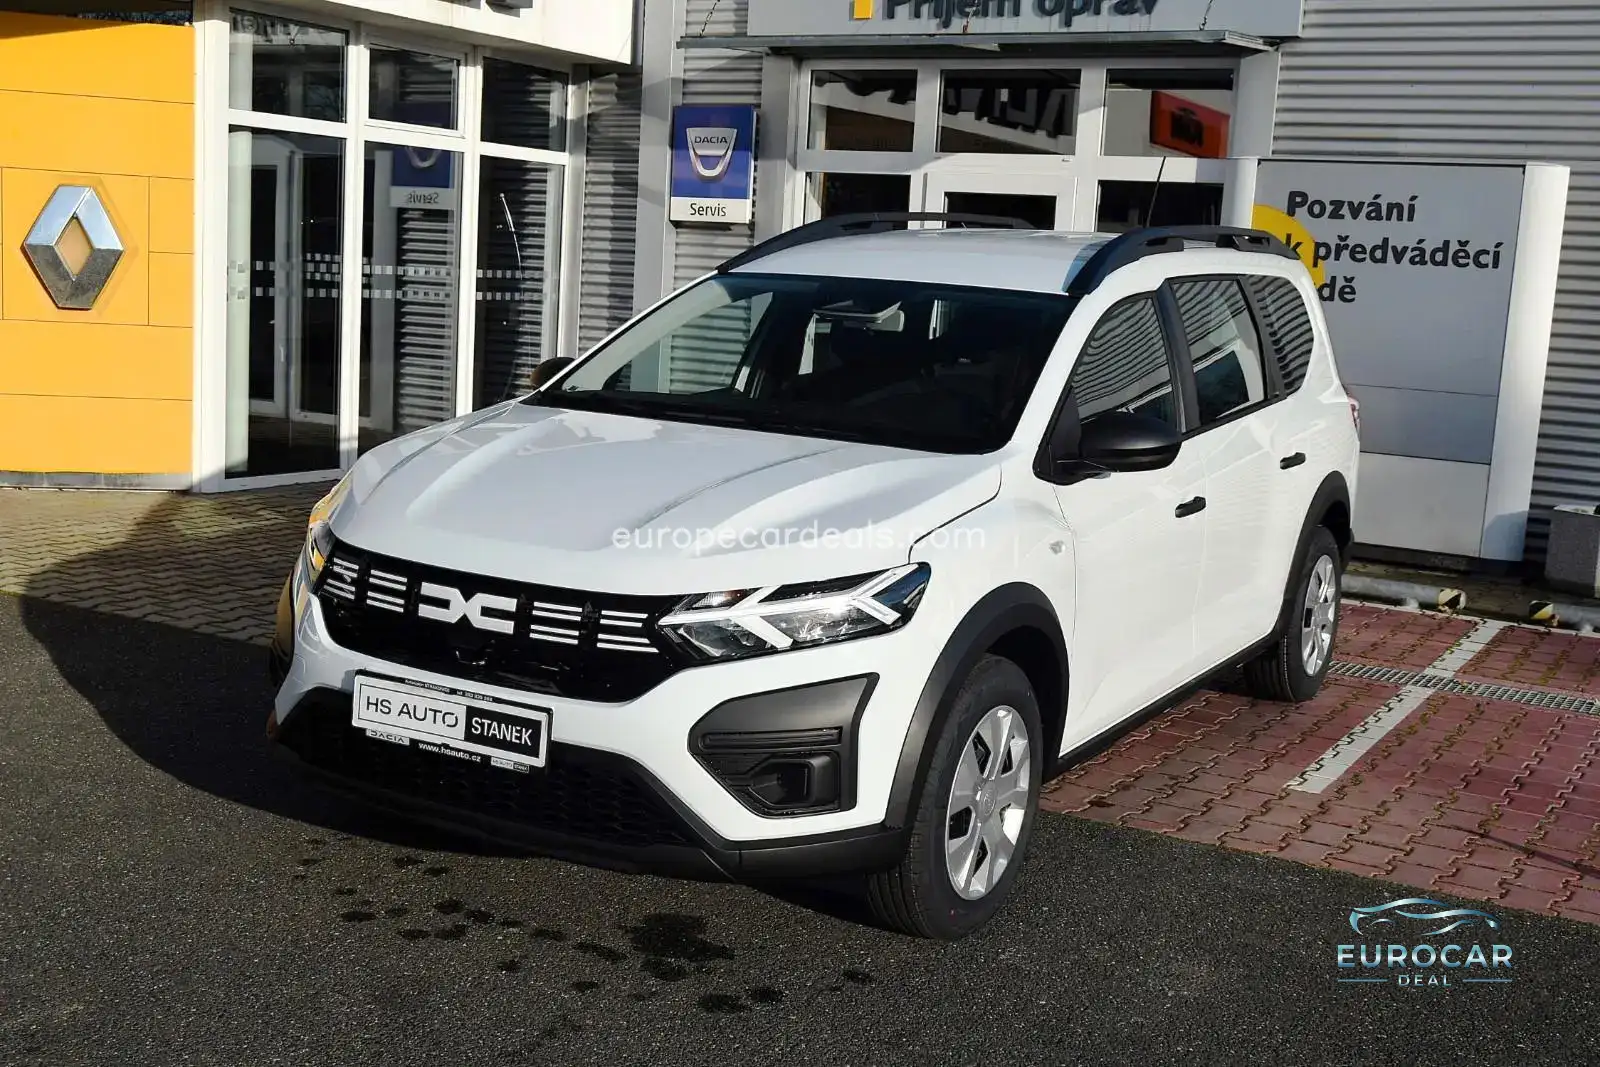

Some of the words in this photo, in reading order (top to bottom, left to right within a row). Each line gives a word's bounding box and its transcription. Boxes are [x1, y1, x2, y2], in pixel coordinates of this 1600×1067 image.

[694, 136, 728, 144] DACIA
[690, 203, 727, 217] Servis
[1286, 190, 1419, 222] Pozvání
[1312, 234, 1504, 269] předváděcí
[366, 696, 392, 714] HS
[398, 702, 459, 728] AUTO
[471, 717, 533, 746] STANEK
[370, 730, 405, 744] DACIA
[418, 741, 482, 763] www.hsauto.cz
